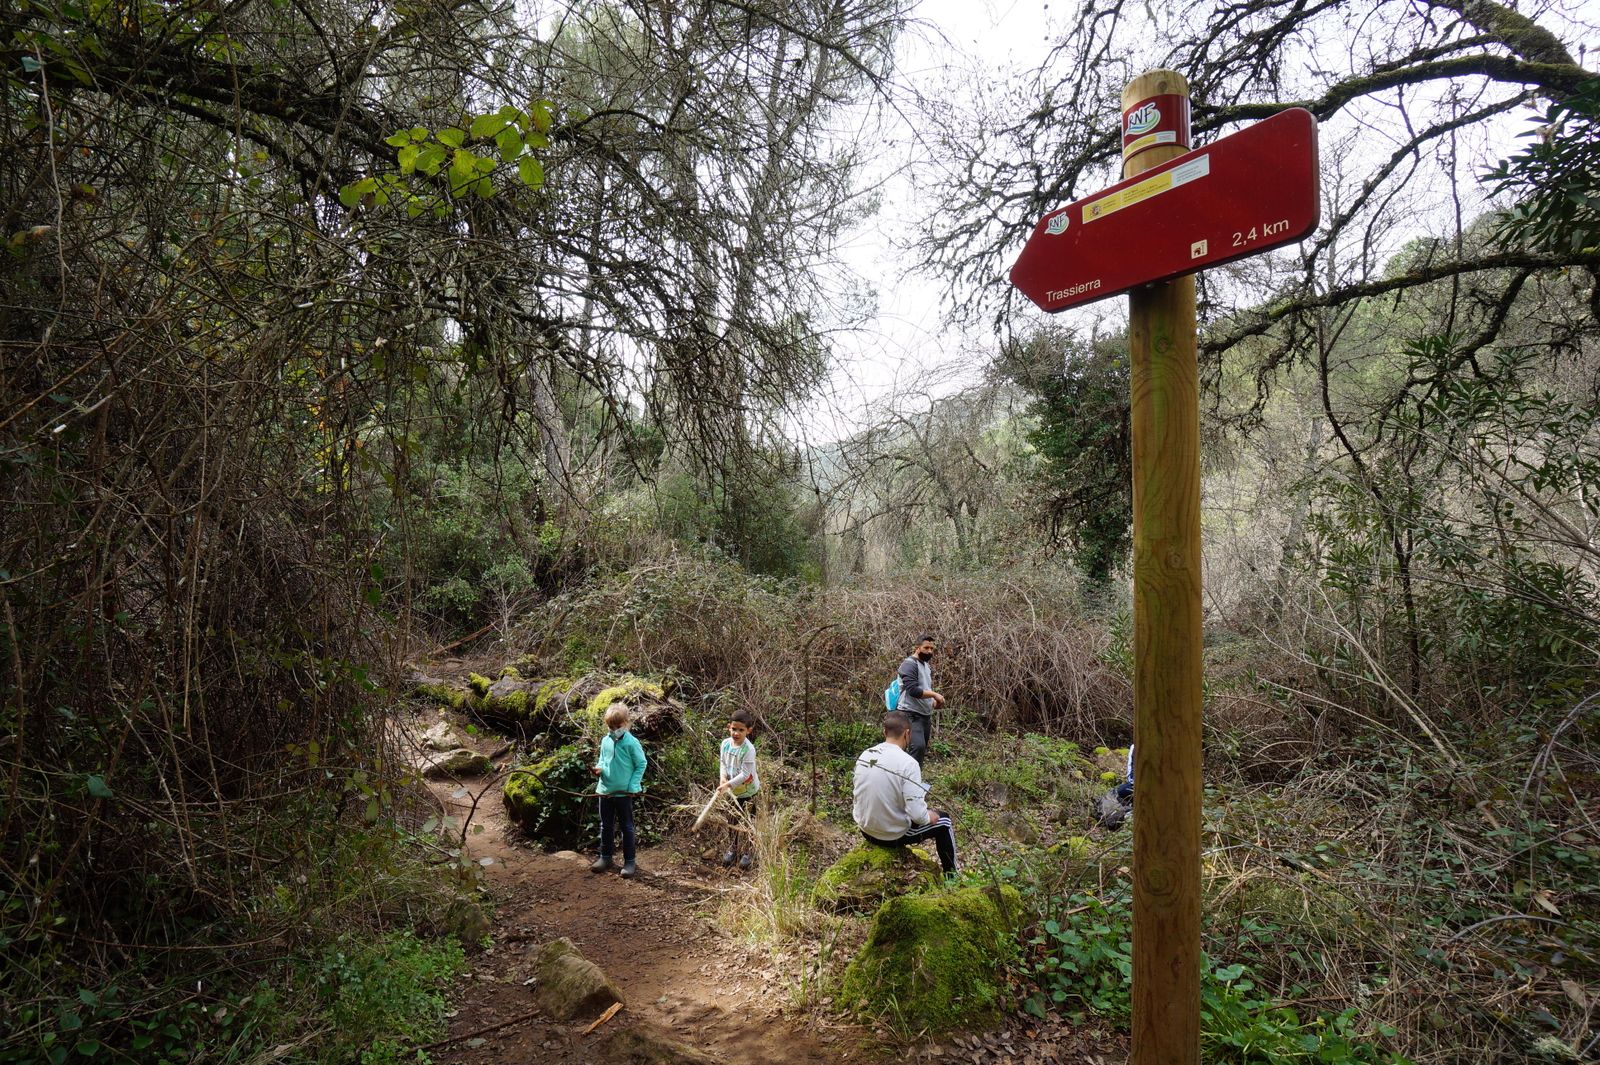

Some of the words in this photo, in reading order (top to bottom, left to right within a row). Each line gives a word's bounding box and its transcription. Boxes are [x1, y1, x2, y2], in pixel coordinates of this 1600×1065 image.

[1232, 227, 1258, 247] 2,4
[1263, 219, 1290, 237] km
[1045, 279, 1101, 302] Trassierra
